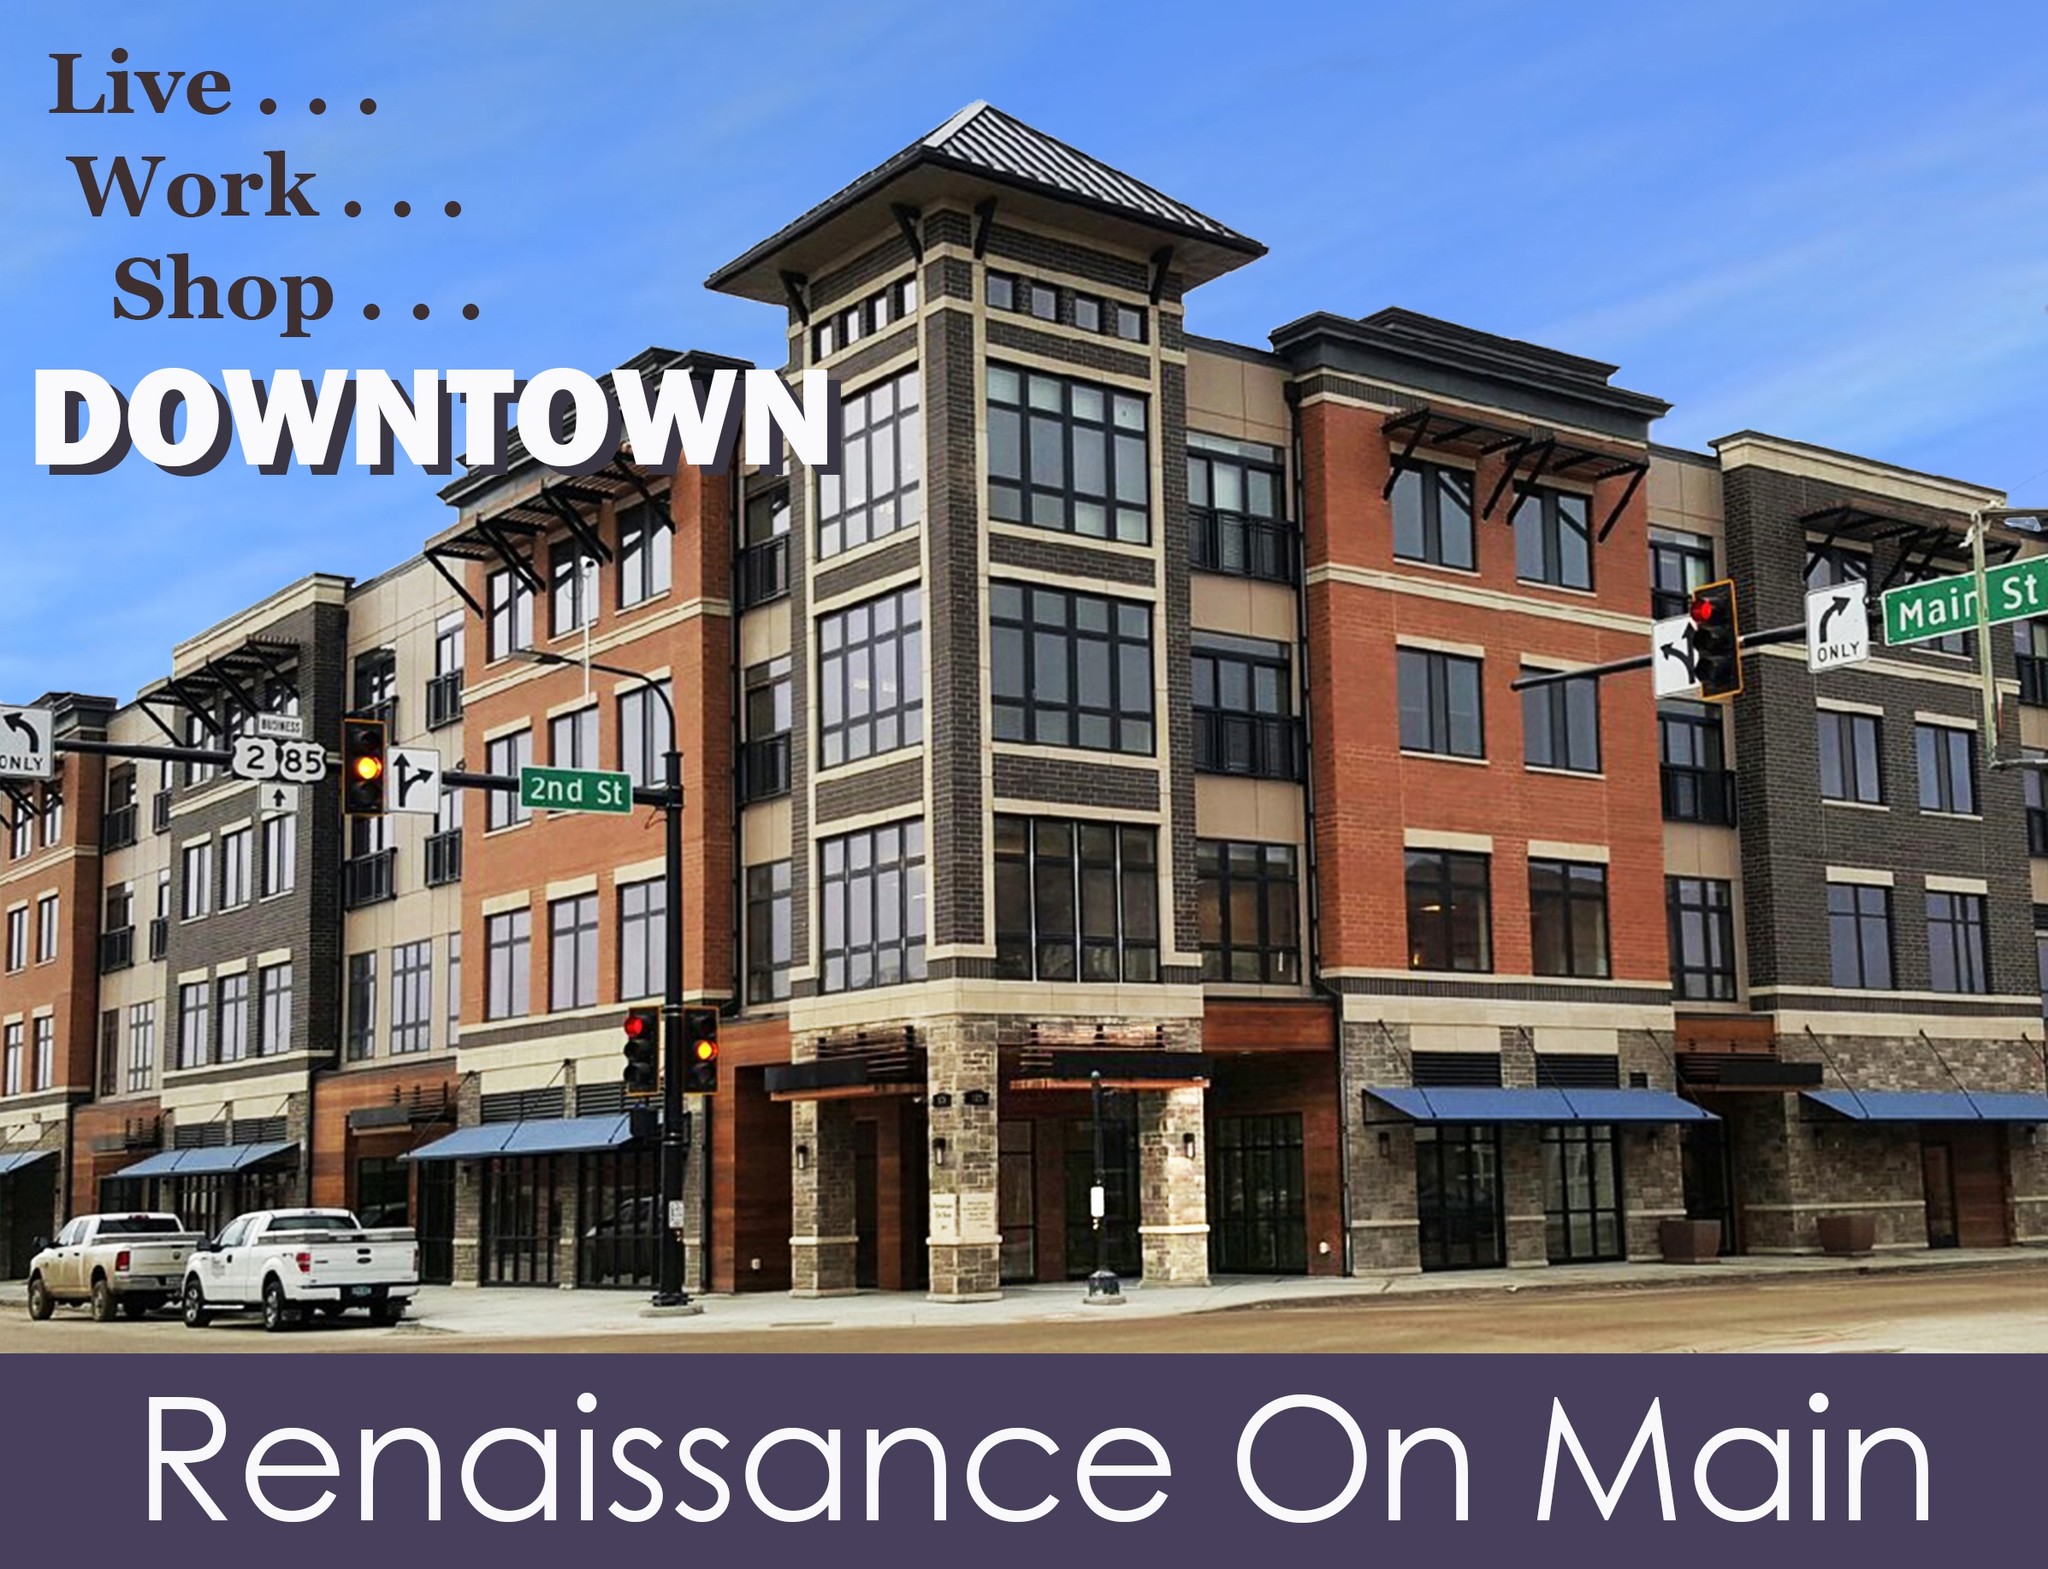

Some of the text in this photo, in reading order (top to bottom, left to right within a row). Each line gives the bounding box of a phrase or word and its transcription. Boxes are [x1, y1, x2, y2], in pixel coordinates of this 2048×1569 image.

[2002, 573, 2039, 610] St
[1817, 641, 1860, 663] ONLY
[261, 718, 302, 734] BUSINESS
[0, 755, 43, 771] ONLY
[246, 745, 265, 770] 2
[284, 748, 322, 775] 85
[530, 776, 623, 806] 2nd St
